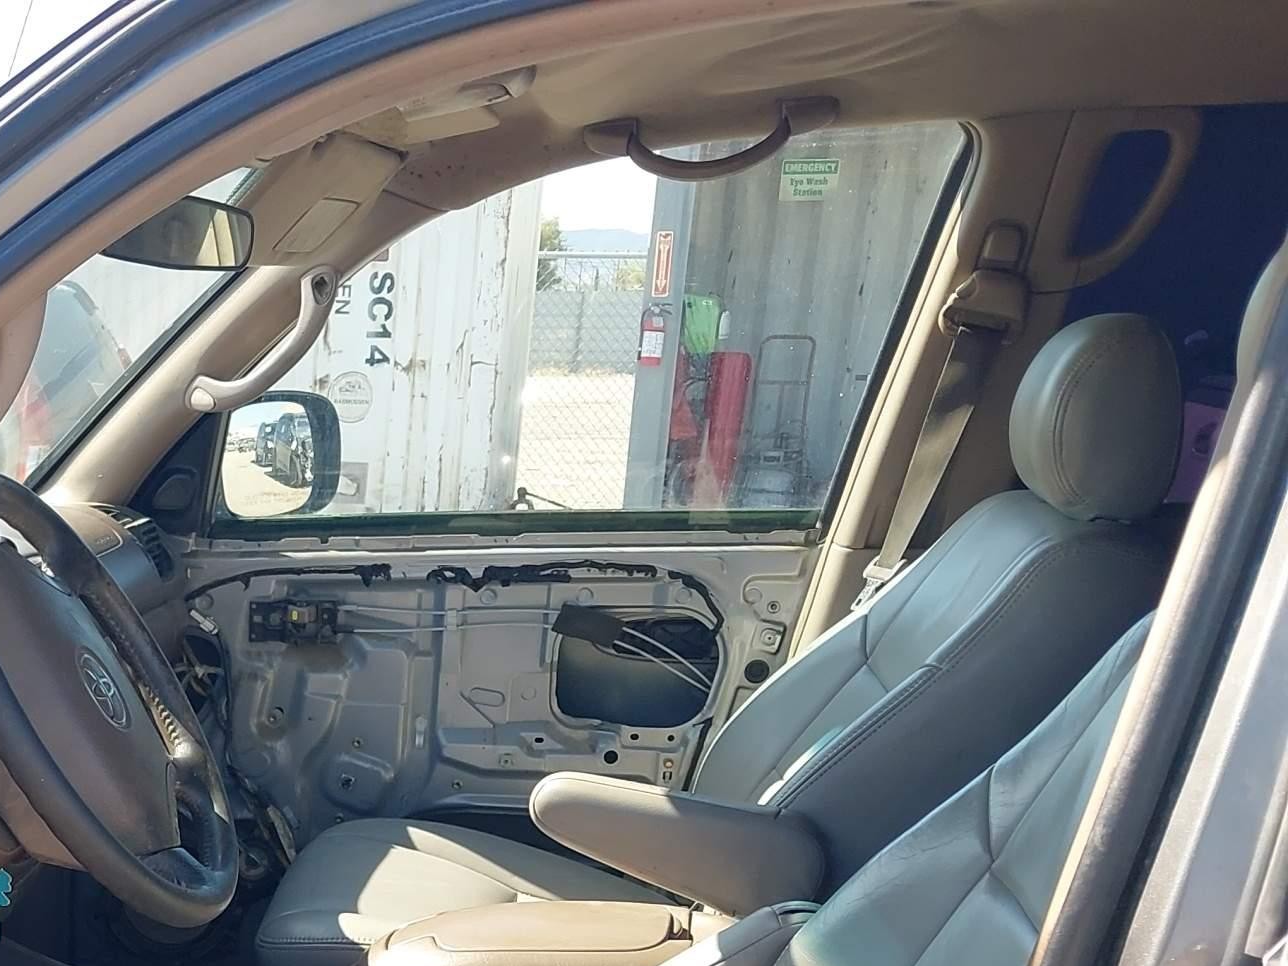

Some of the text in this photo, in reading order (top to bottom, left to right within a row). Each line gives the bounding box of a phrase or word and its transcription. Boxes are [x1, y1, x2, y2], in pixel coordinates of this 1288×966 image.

[785, 163, 838, 173] EMERGENCY
[790, 176, 829, 187] Eye Wash
[792, 188, 823, 197] Station
[365, 271, 396, 367] SC14
